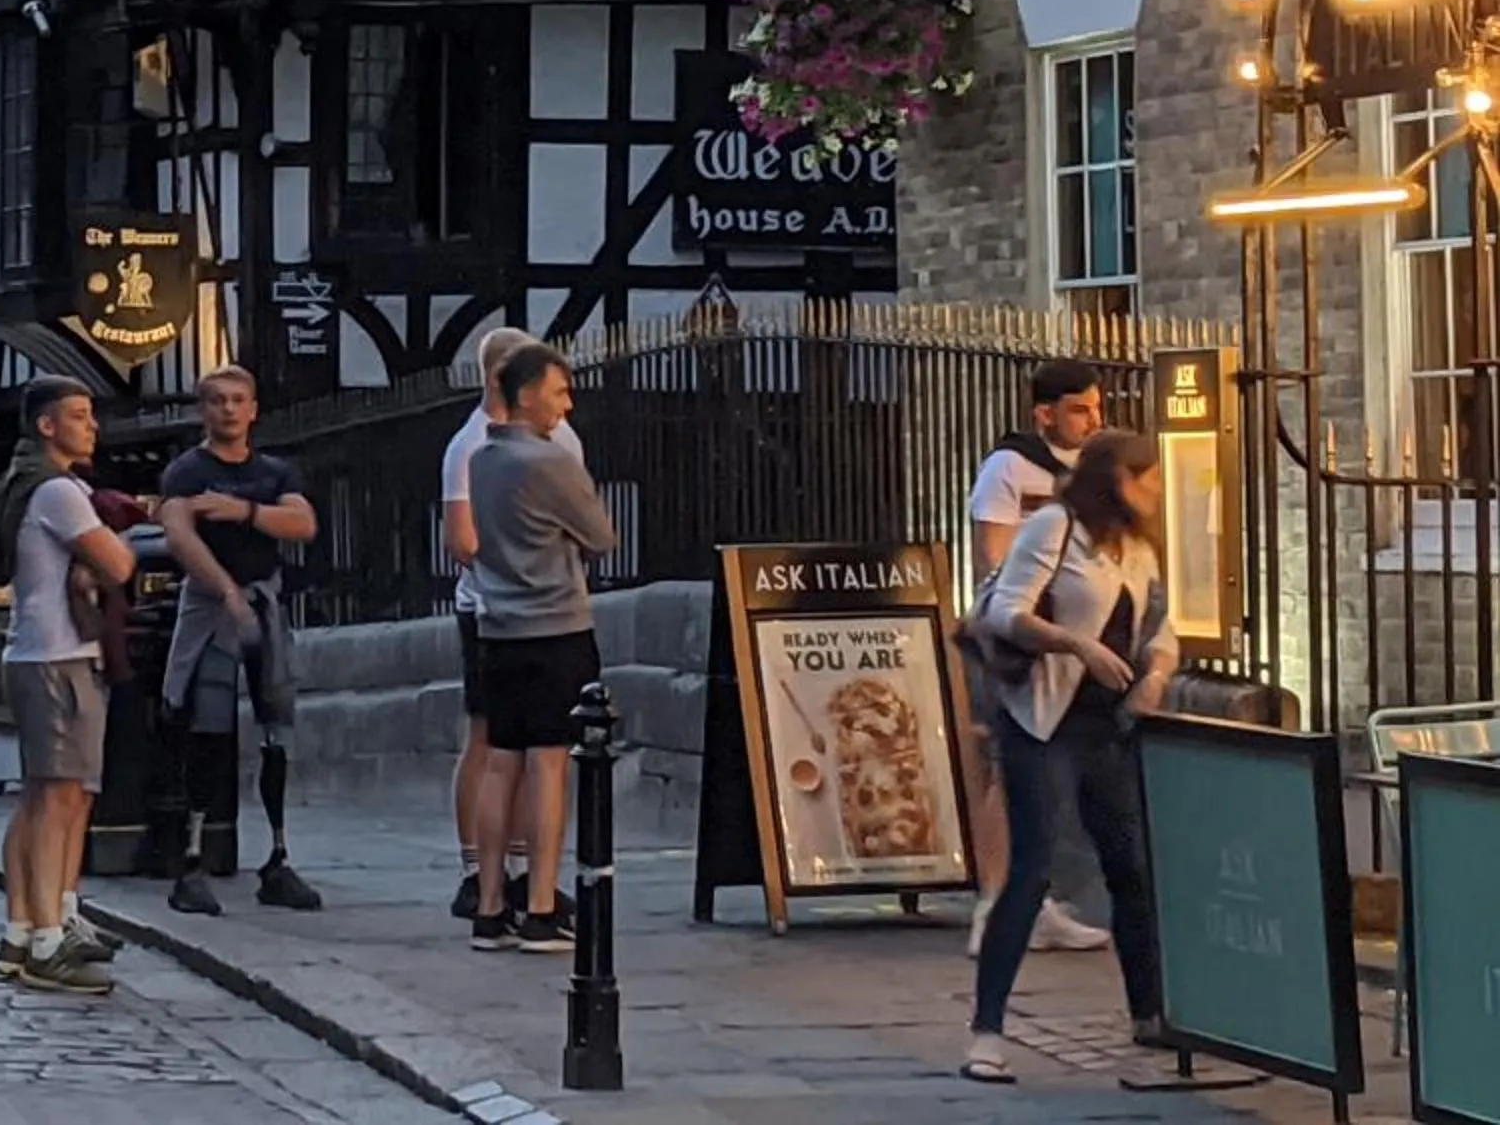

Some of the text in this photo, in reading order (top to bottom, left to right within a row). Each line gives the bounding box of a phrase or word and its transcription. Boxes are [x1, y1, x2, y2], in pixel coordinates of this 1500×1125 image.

[687, 193, 896, 239] house A.D.
[91, 318, 177, 345] Restaurant
[755, 561, 925, 592] ASK ITALIAN
[784, 632, 840, 648] READY
[787, 648, 906, 672] YOU ARE
